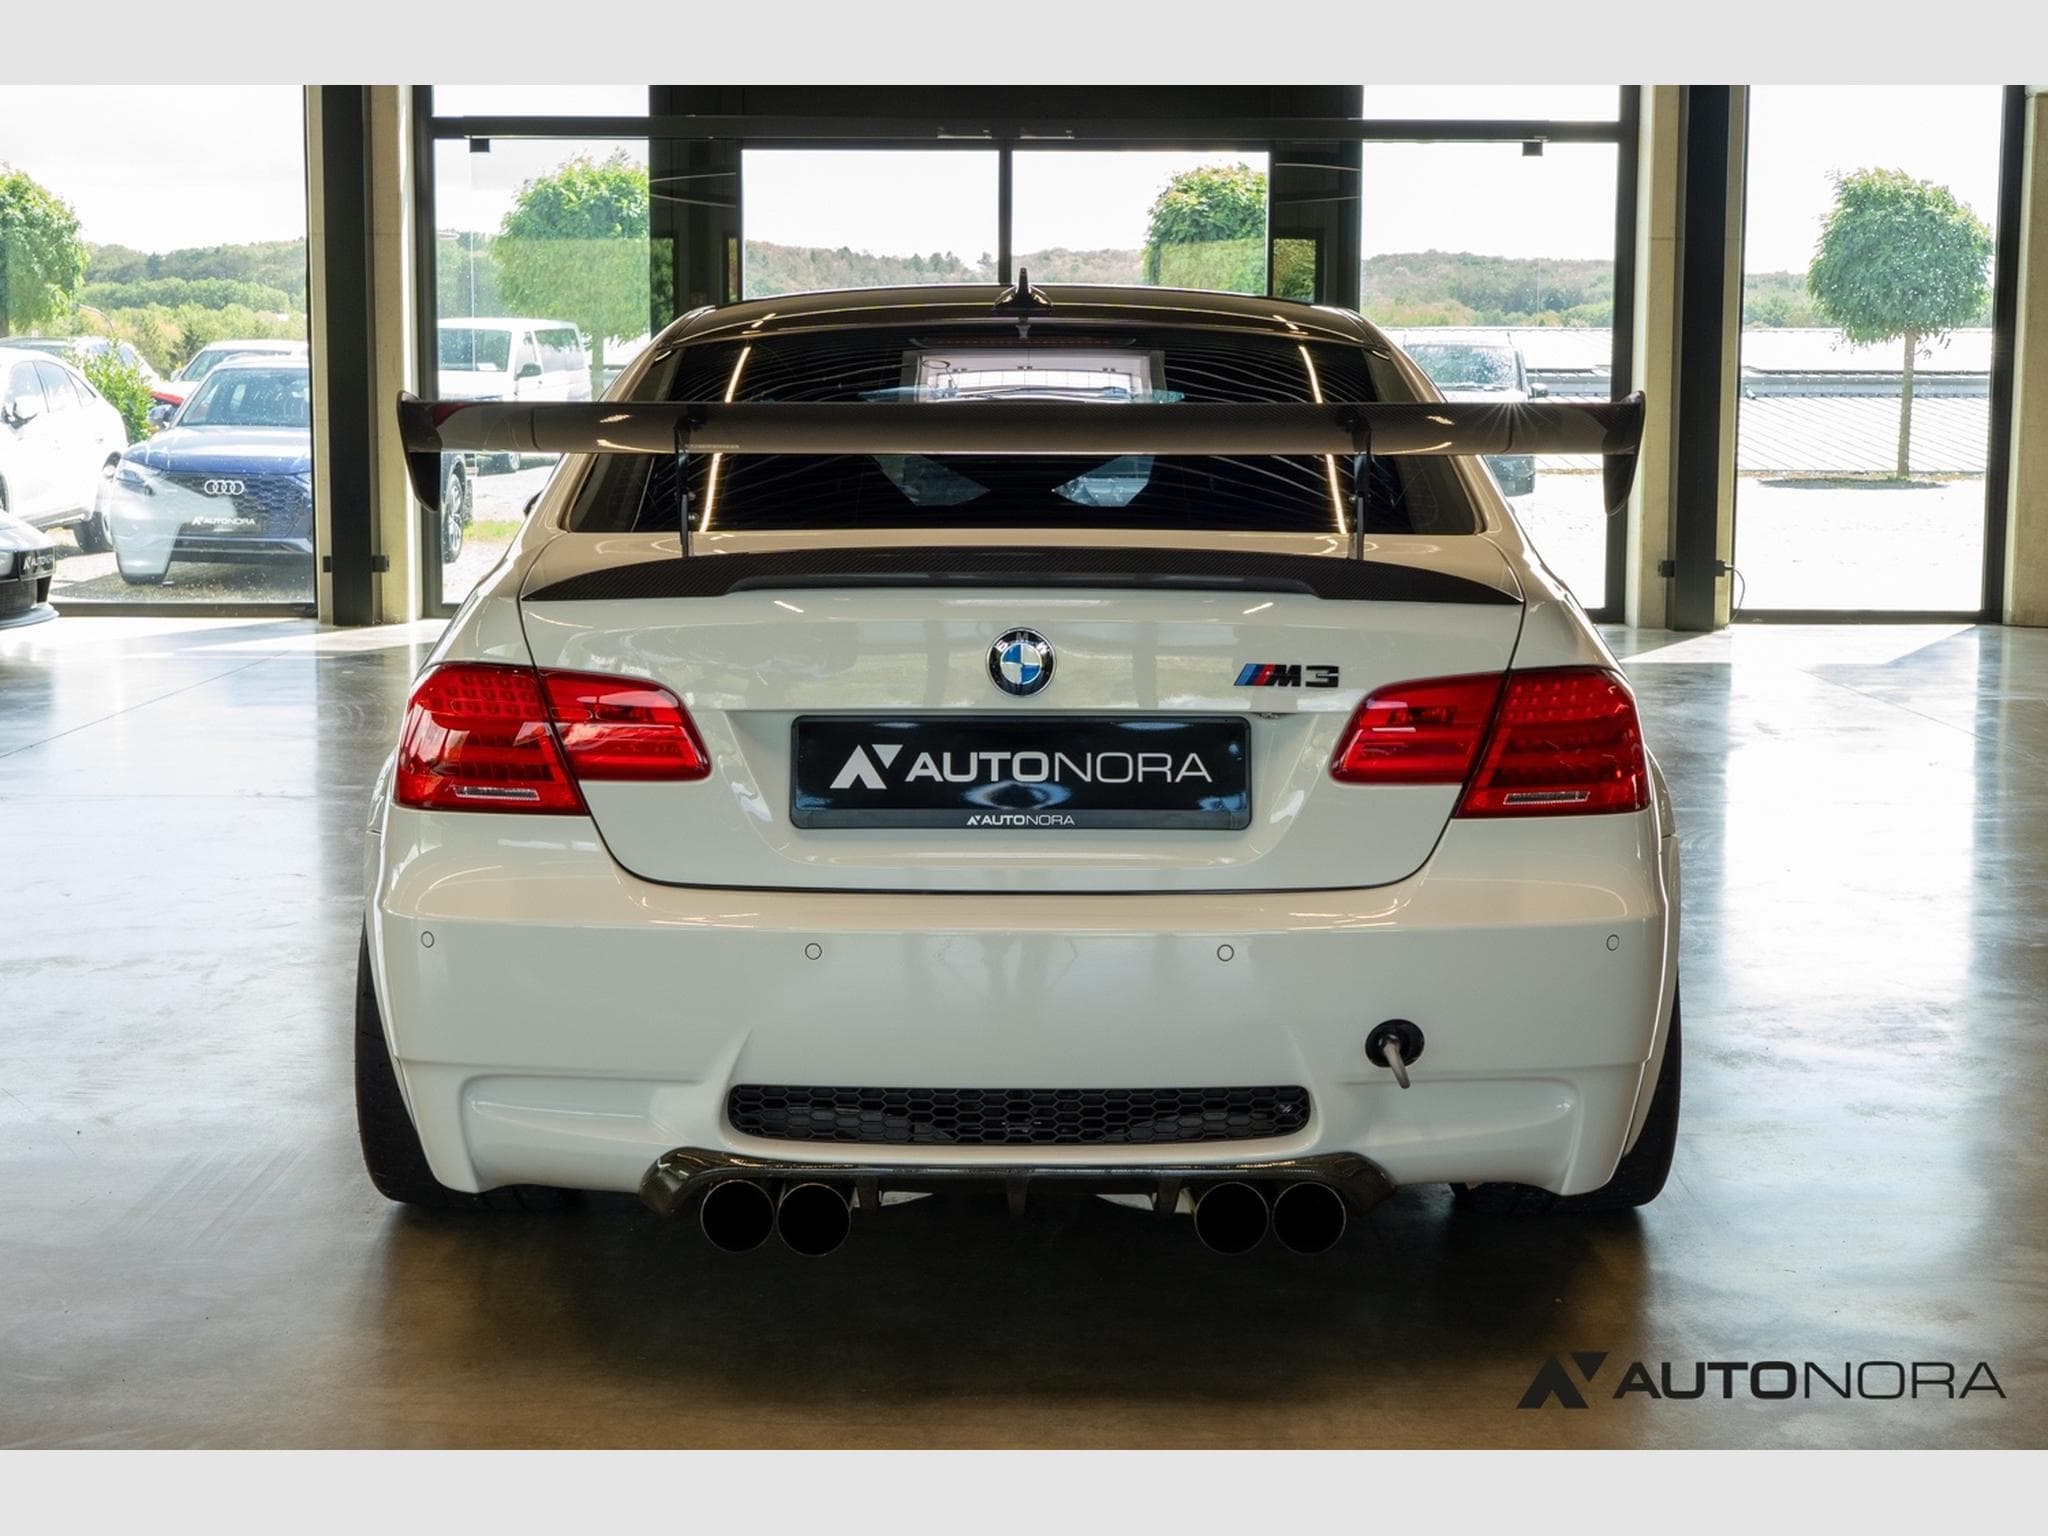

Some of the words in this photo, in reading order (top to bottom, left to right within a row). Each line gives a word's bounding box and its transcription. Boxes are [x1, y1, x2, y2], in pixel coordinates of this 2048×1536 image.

[994, 632, 1050, 655] BMW
[1262, 663, 1339, 688] M3
[906, 751, 1212, 783] AUTONORA
[981, 815, 1075, 826] AUTONORA
